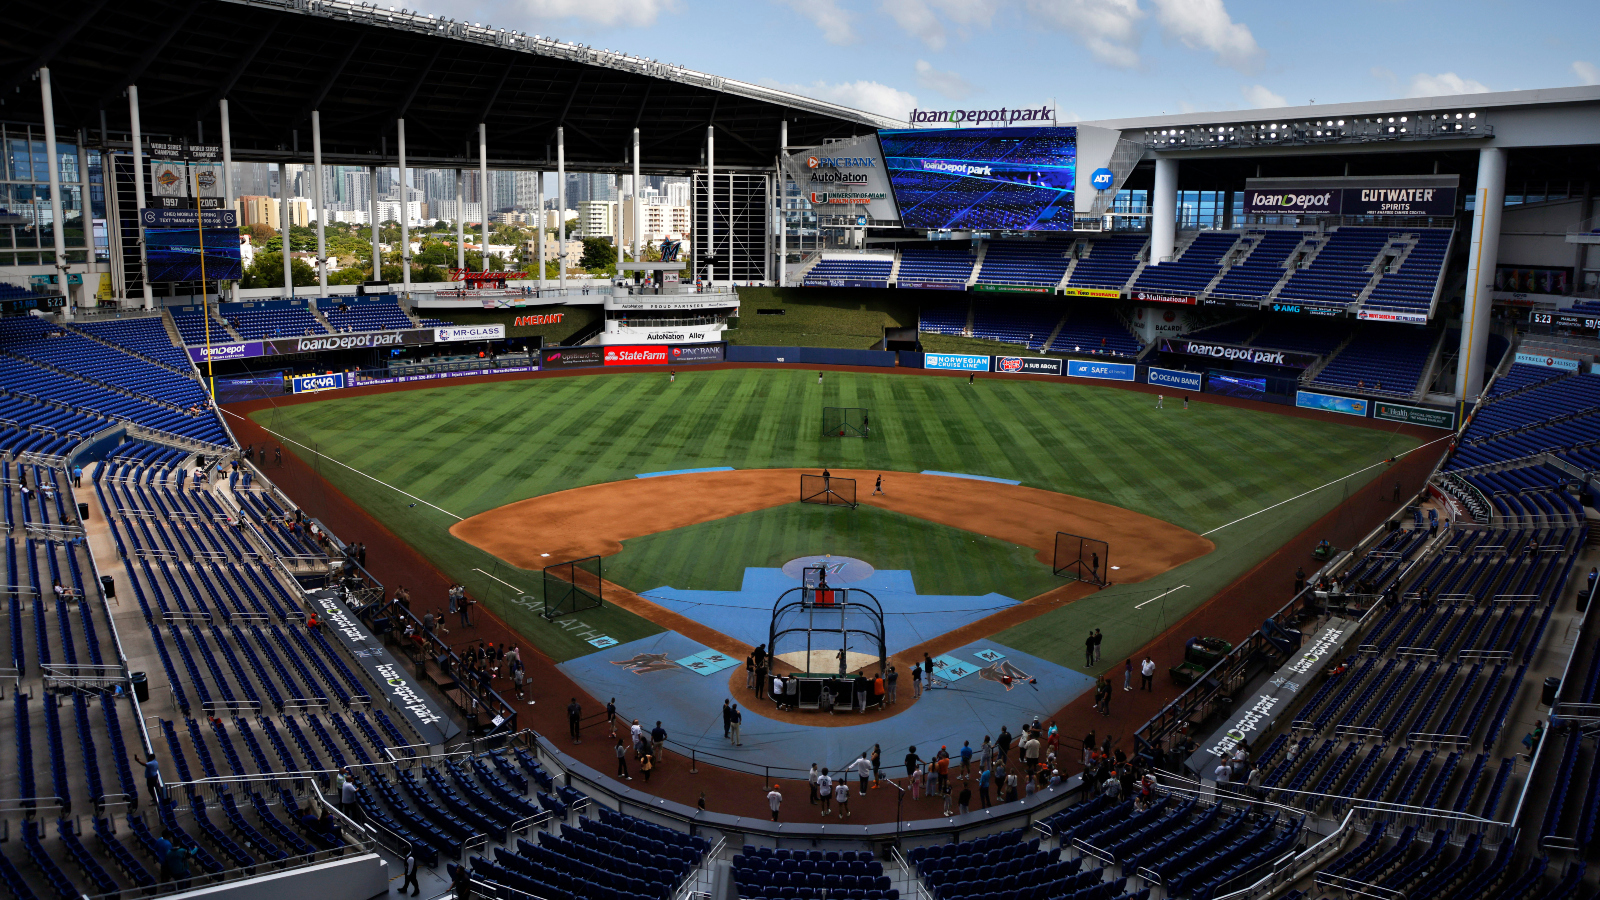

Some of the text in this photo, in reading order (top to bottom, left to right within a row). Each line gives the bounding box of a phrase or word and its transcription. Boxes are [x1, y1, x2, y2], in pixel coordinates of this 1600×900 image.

[911, 106, 1051, 125] loanDepot park
[923, 161, 992, 176] loanDepot park
[811, 172, 867, 181] AutoNation
[1093, 175, 1112, 184] ADT
[1251, 192, 1331, 209] loanDepot
[1361, 188, 1433, 202] CUTWATER
[162, 198, 179, 206] 1997
[200, 199, 218, 207] 2003
[448, 267, 529, 281] Budweiser
[47, 297, 63, 307] 5:23
[1146, 293, 1188, 303] Multinational
[1281, 305, 1300, 313] AMG
[514, 313, 564, 327] AMERANT
[1534, 313, 1551, 324] 5:23
[297, 331, 403, 351] loanDepot park
[647, 332, 705, 341] AutoNation Alley
[1186, 341, 1285, 364] loanDepot park
[938, 355, 987, 365] NORWEGIAN
[1553, 360, 1577, 368] JALISCO
[1091, 366, 1108, 374] SAFE
[303, 377, 334, 389] GOYA
[1158, 374, 1199, 386] OCEAN BANK
[1322, 627, 1343, 645] park
[375, 663, 441, 725] loanDepot park
[1206, 694, 1279, 757] loanDepot park
